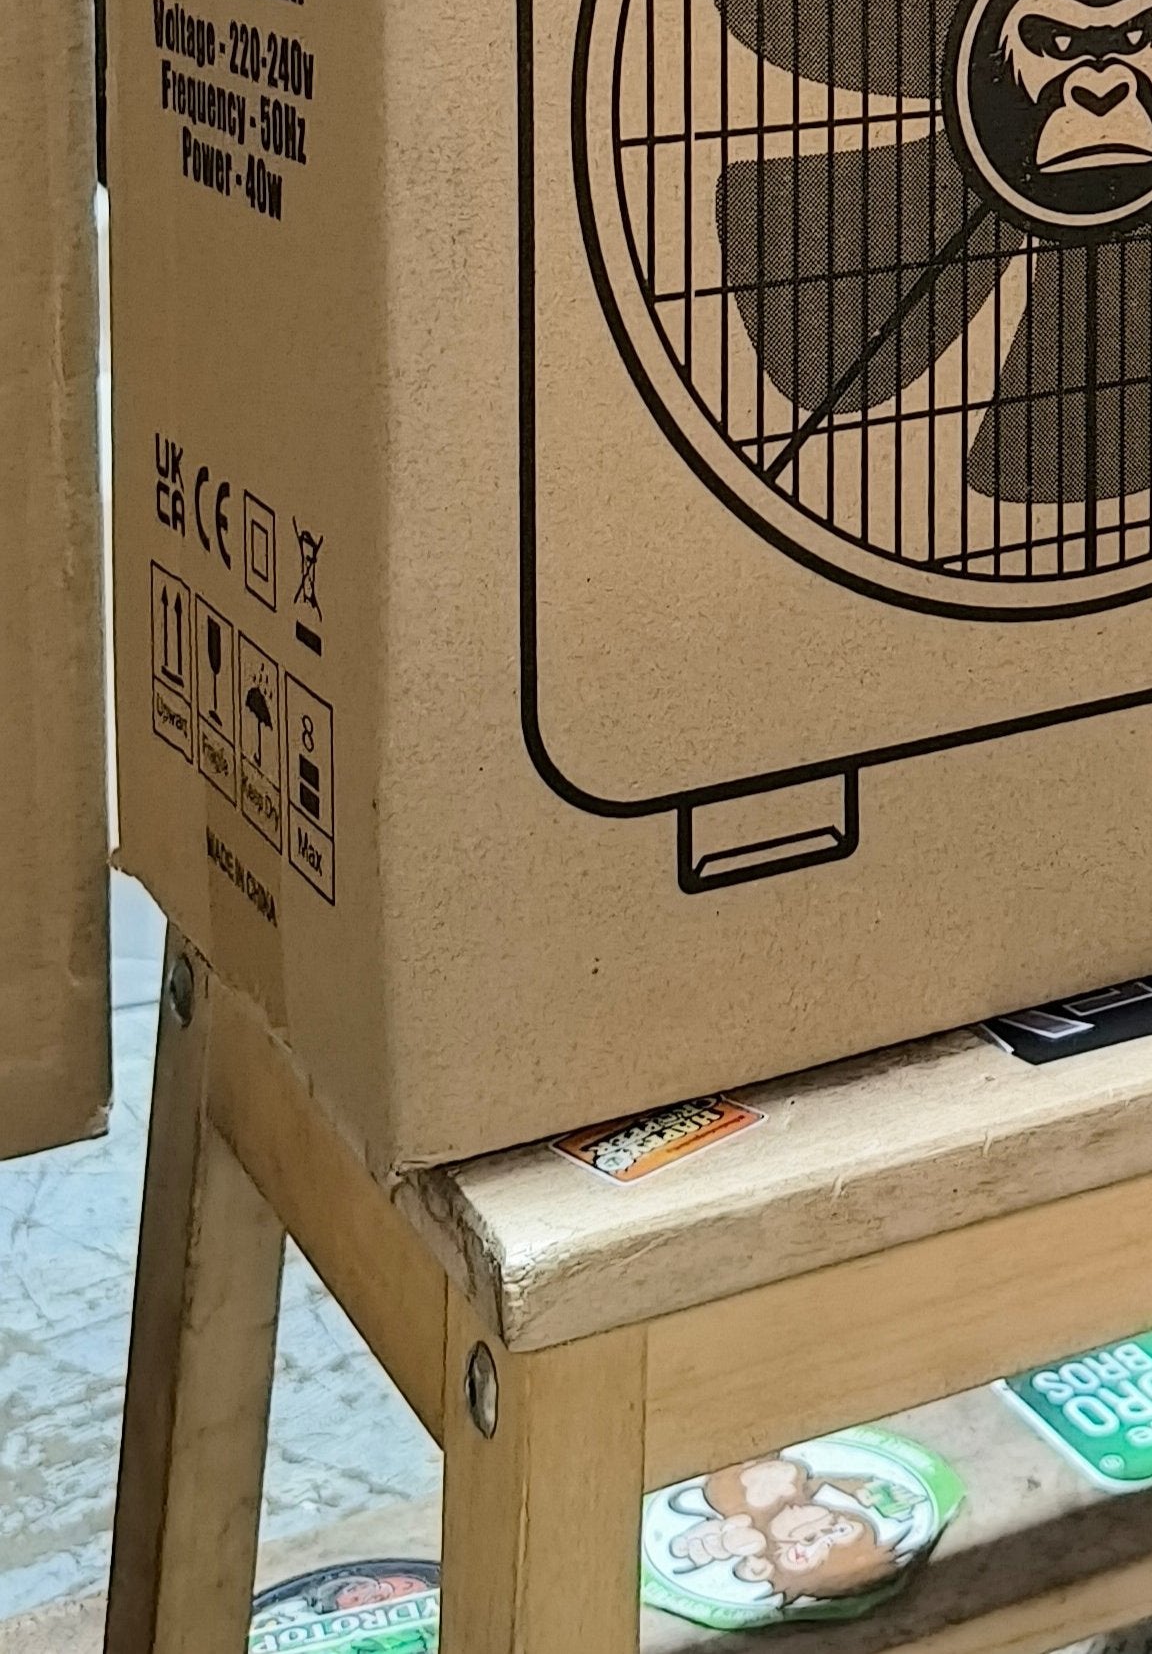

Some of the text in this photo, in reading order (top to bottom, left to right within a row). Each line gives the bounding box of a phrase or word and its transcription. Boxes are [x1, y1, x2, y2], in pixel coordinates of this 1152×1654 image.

[161, 59, 246, 145] Frequency
[260, 94, 306, 165] 50Hz
[182, 126, 232, 196] Power
[155, 432, 185, 494] UK
[156, 480, 186, 538] CA
[195, 465, 231, 570] CE
[298, 826, 323, 878] Max
